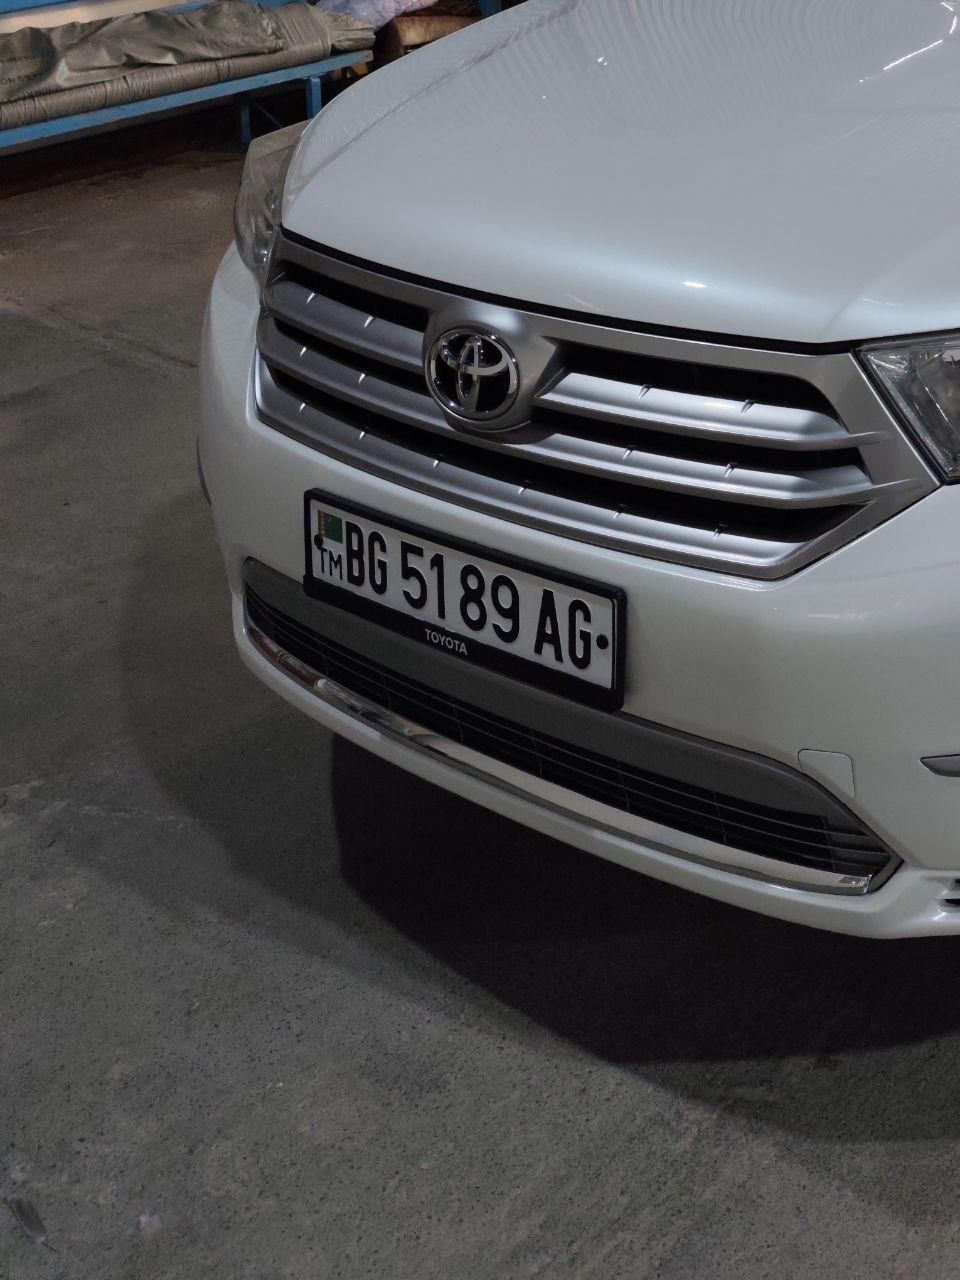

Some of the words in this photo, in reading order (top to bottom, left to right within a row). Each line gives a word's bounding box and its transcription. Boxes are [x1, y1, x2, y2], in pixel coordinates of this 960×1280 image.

[317, 546, 343, 581] TM
[345, 520, 388, 596] BG
[400, 540, 520, 644] 5189
[534, 588, 592, 670] AG
[424, 628, 468, 656] TOYOTA
